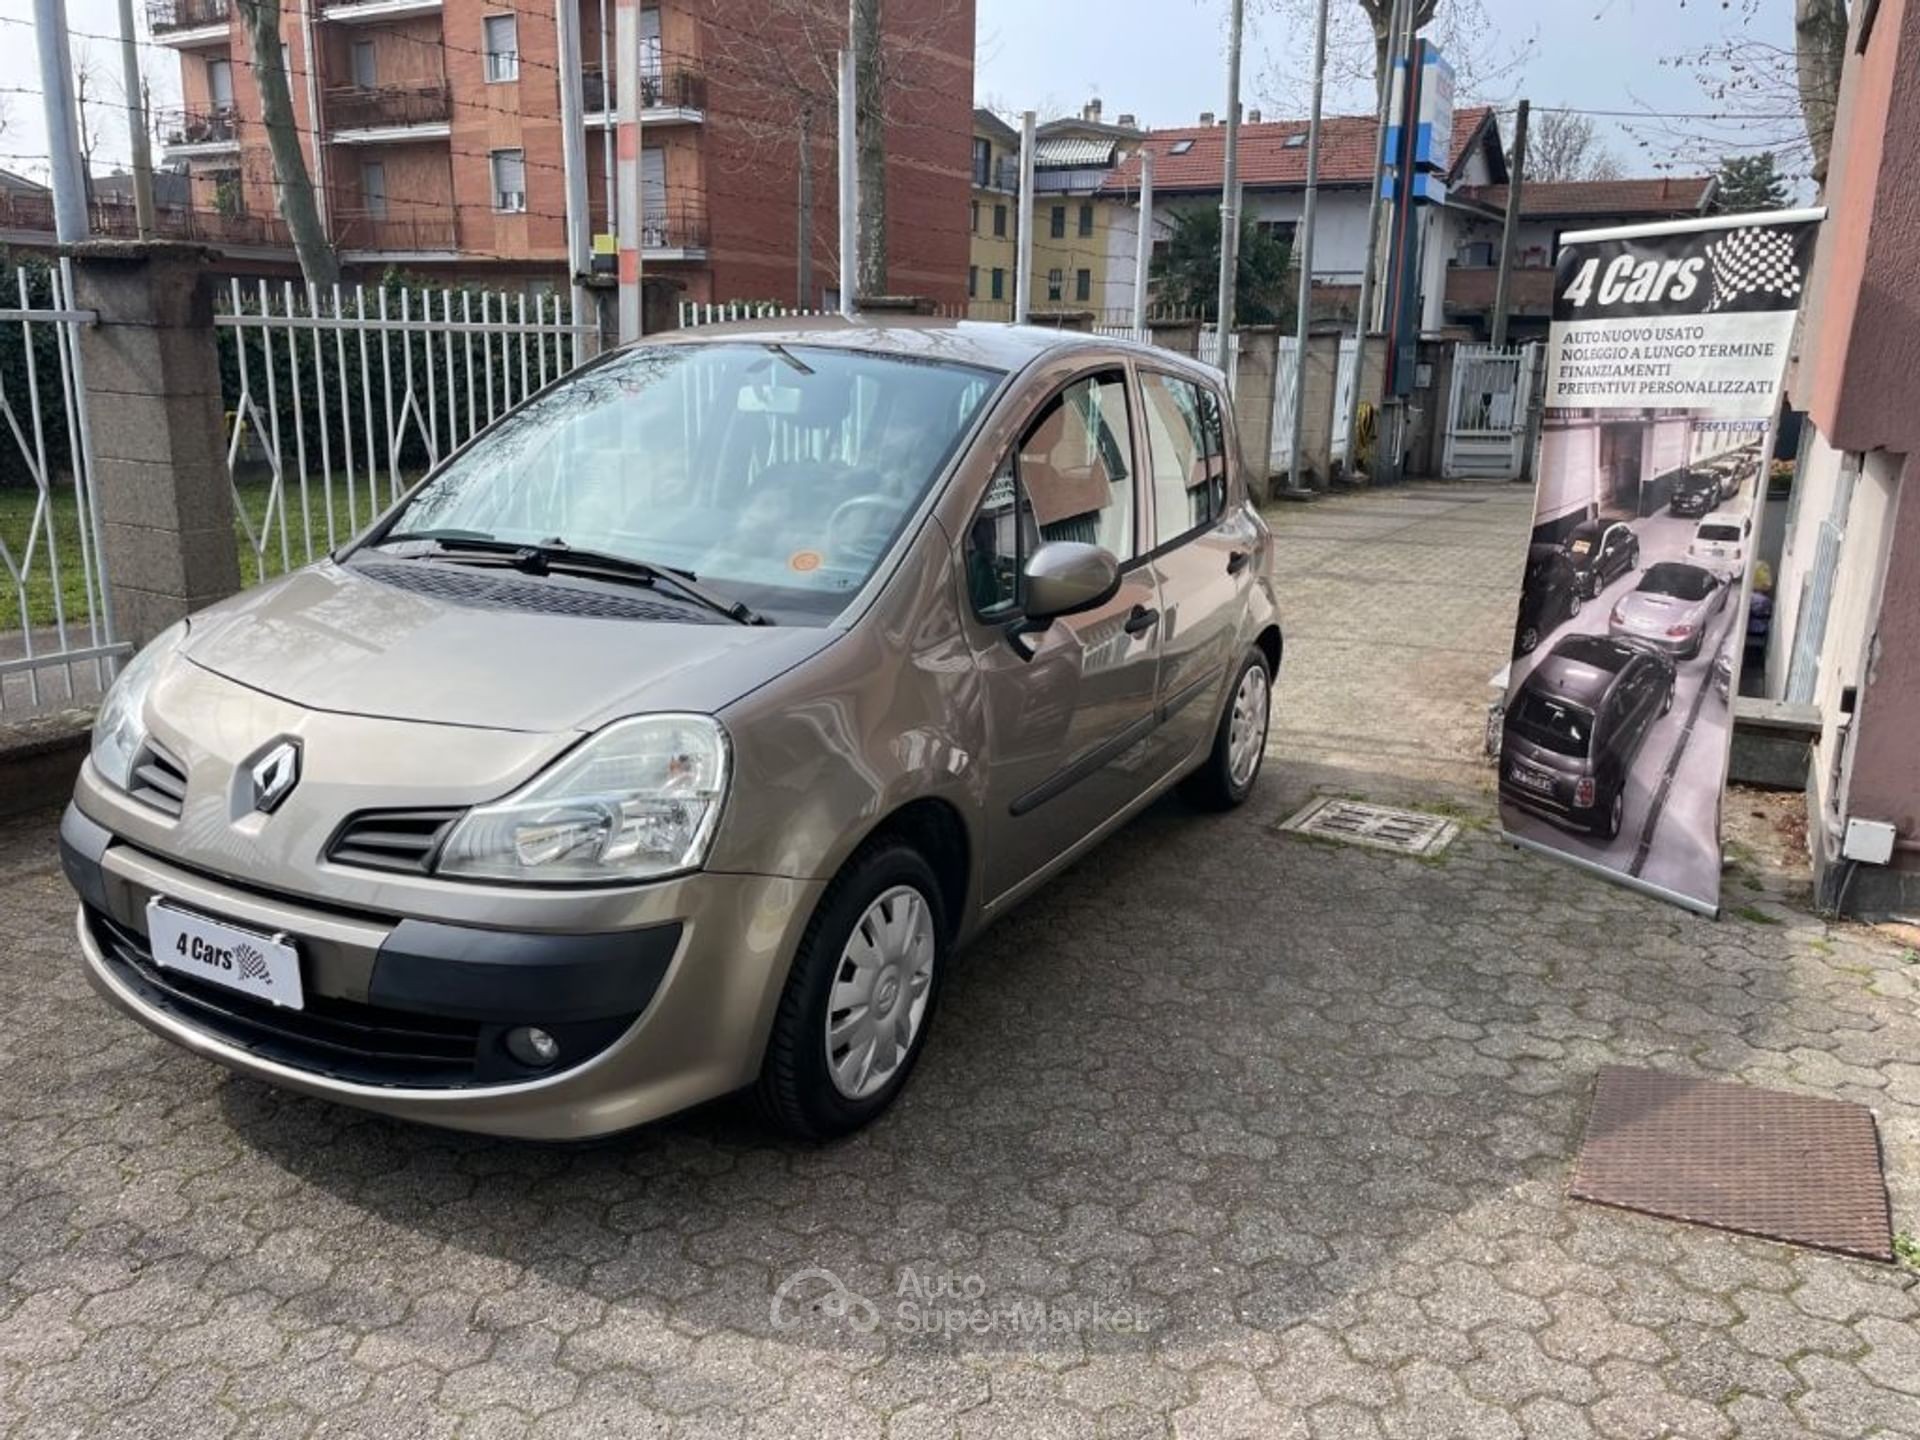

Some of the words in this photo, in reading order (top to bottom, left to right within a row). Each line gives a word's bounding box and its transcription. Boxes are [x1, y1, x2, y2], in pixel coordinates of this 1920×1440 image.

[1562, 258, 1600, 307] 4
[1597, 254, 1705, 306] Cars
[1655, 326, 1704, 341] USATO
[1561, 346, 1629, 361] NOLEGGIO
[1630, 346, 1641, 360] A
[1644, 345, 1696, 359] LUNGO
[1698, 343, 1775, 357] TERMINE
[1560, 363, 1671, 378] FINANZIAMENTI
[1557, 381, 1637, 395] PREVENTIVI
[1639, 380, 1774, 394] PERSONALIZZATI
[176, 932, 187, 956] 4
[192, 936, 233, 971] Cars
